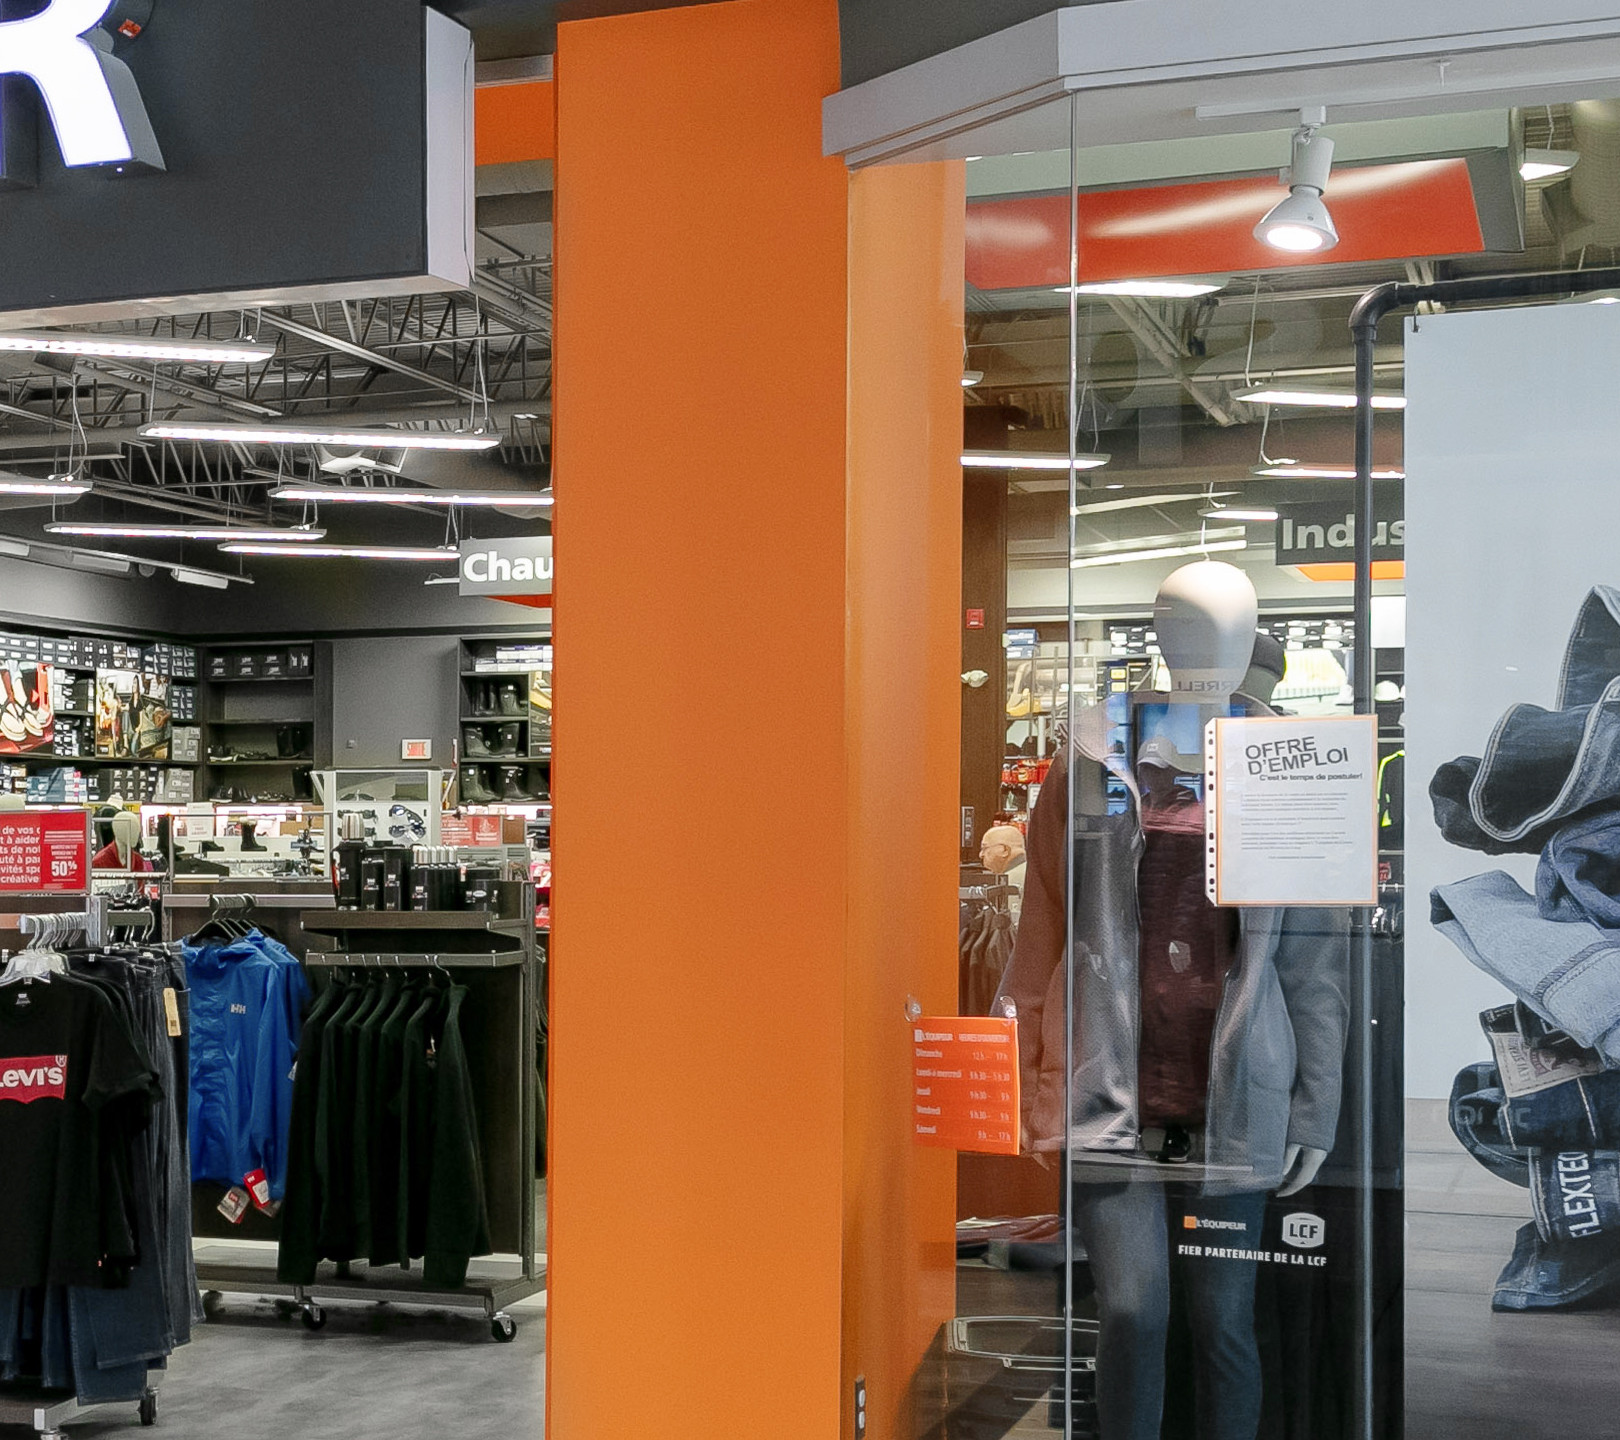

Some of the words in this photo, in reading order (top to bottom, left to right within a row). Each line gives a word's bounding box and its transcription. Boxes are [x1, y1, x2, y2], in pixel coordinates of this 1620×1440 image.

[463, 550, 553, 582] Chau
[1245, 736, 1317, 760] OFFRE
[1247, 747, 1349, 775] D'EMPLOI
[2, 826, 14, 835] de
[17, 827, 34, 835] vos
[7, 835, 12, 845] à
[15, 836, 40, 845] aider
[11, 845, 23, 854] de
[17, 855, 23, 864] à
[51, 860, 77, 877] 50%
[1289, 1223, 1319, 1239] LCF
[1178, 1244, 1202, 1256] FIER
[1204, 1246, 1271, 1262] PARTENAIRE
[1273, 1252, 1288, 1263] DE
[1291, 1254, 1304, 1265] LA
[1307, 1256, 1327, 1267] LCF
